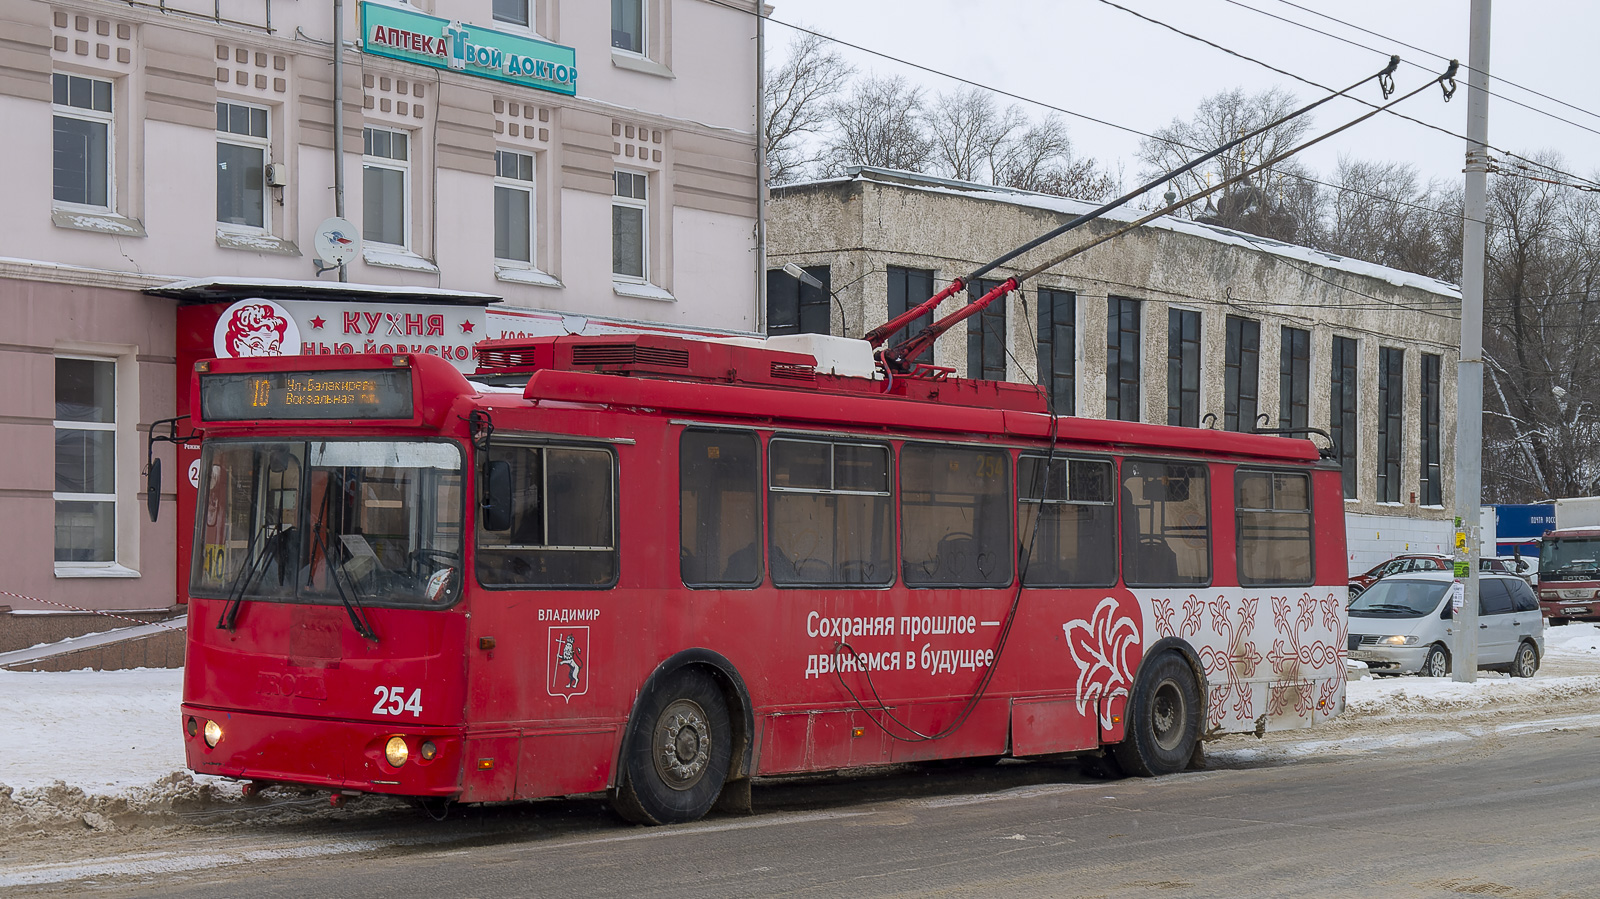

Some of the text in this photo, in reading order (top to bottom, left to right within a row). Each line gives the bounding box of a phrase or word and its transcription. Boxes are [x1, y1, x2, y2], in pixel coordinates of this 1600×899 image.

[374, 25, 448, 57] АПТЕКА
[508, 54, 578, 85] ДОКТОР
[343, 311, 444, 336] КУХНЯ
[252, 379, 270, 407] 10
[285, 392, 355, 405] Вокзальная
[976, 454, 1004, 478] 254
[208, 547, 225, 580] 10
[538, 608, 601, 623] ВЛАДИМИР
[806, 610, 895, 644] Сохраняя
[900, 614, 976, 642] прошлое
[805, 642, 994, 679] движемся в будущее
[372, 685, 423, 717] 254
